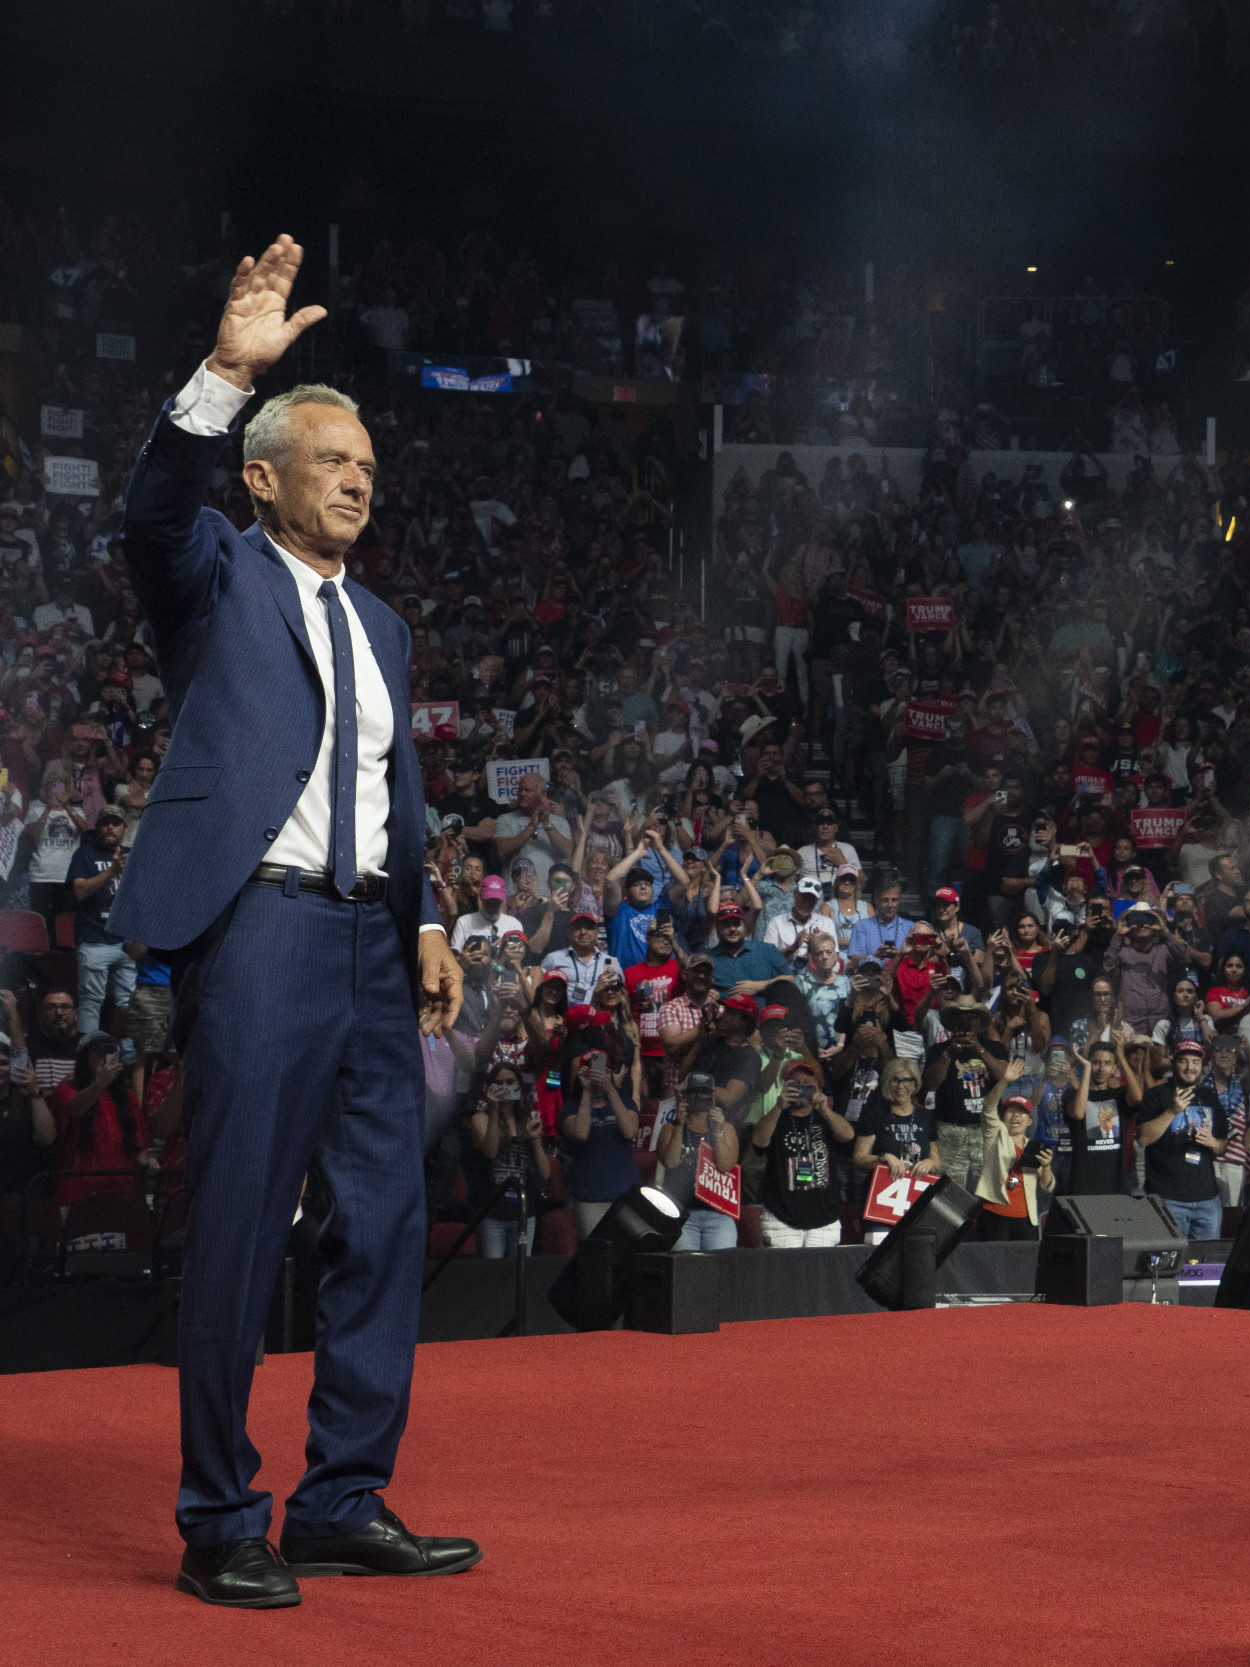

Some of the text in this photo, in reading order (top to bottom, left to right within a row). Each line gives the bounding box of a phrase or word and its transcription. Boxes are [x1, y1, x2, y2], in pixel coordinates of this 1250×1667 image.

[909, 605, 952, 614] TRUMP
[914, 612, 949, 620] VANCE
[412, 706, 453, 733] 47
[908, 709, 945, 723] TRUM
[496, 764, 540, 777] FIGHT!
[497, 777, 521, 788] FIG
[498, 787, 519, 798] FIG
[1134, 818, 1184, 829] TRUMP
[1140, 827, 1178, 836] VANCE
[1095, 1138, 1114, 1146] NEVER
[702, 1162, 735, 1190] VANCE
[698, 1174, 739, 1205] TRUMP
[1181, 1268, 1203, 1278] MDG
